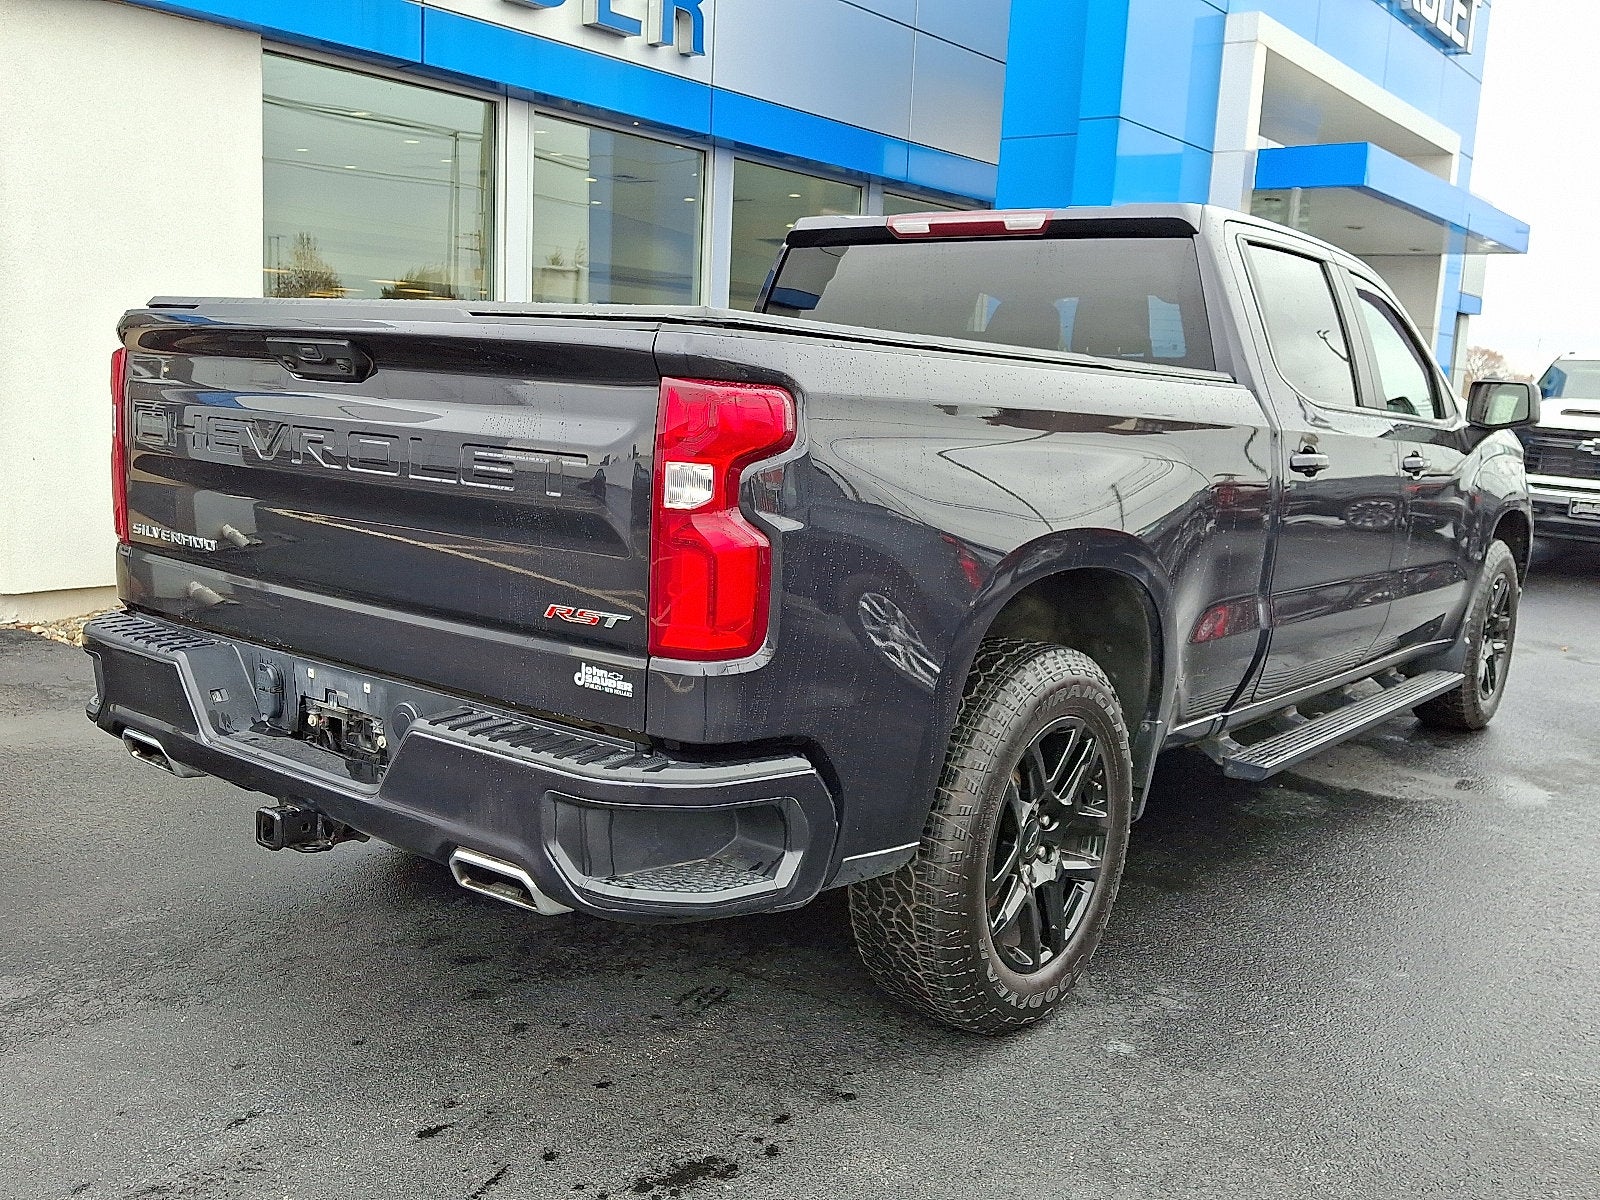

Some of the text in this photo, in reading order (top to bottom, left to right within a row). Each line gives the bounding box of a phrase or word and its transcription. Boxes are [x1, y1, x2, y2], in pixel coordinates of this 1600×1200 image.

[135, 405, 589, 498] CHEVROLET
[131, 522, 219, 553] SILVERADO
[543, 603, 633, 629] RST
[574, 661, 609, 686] John
